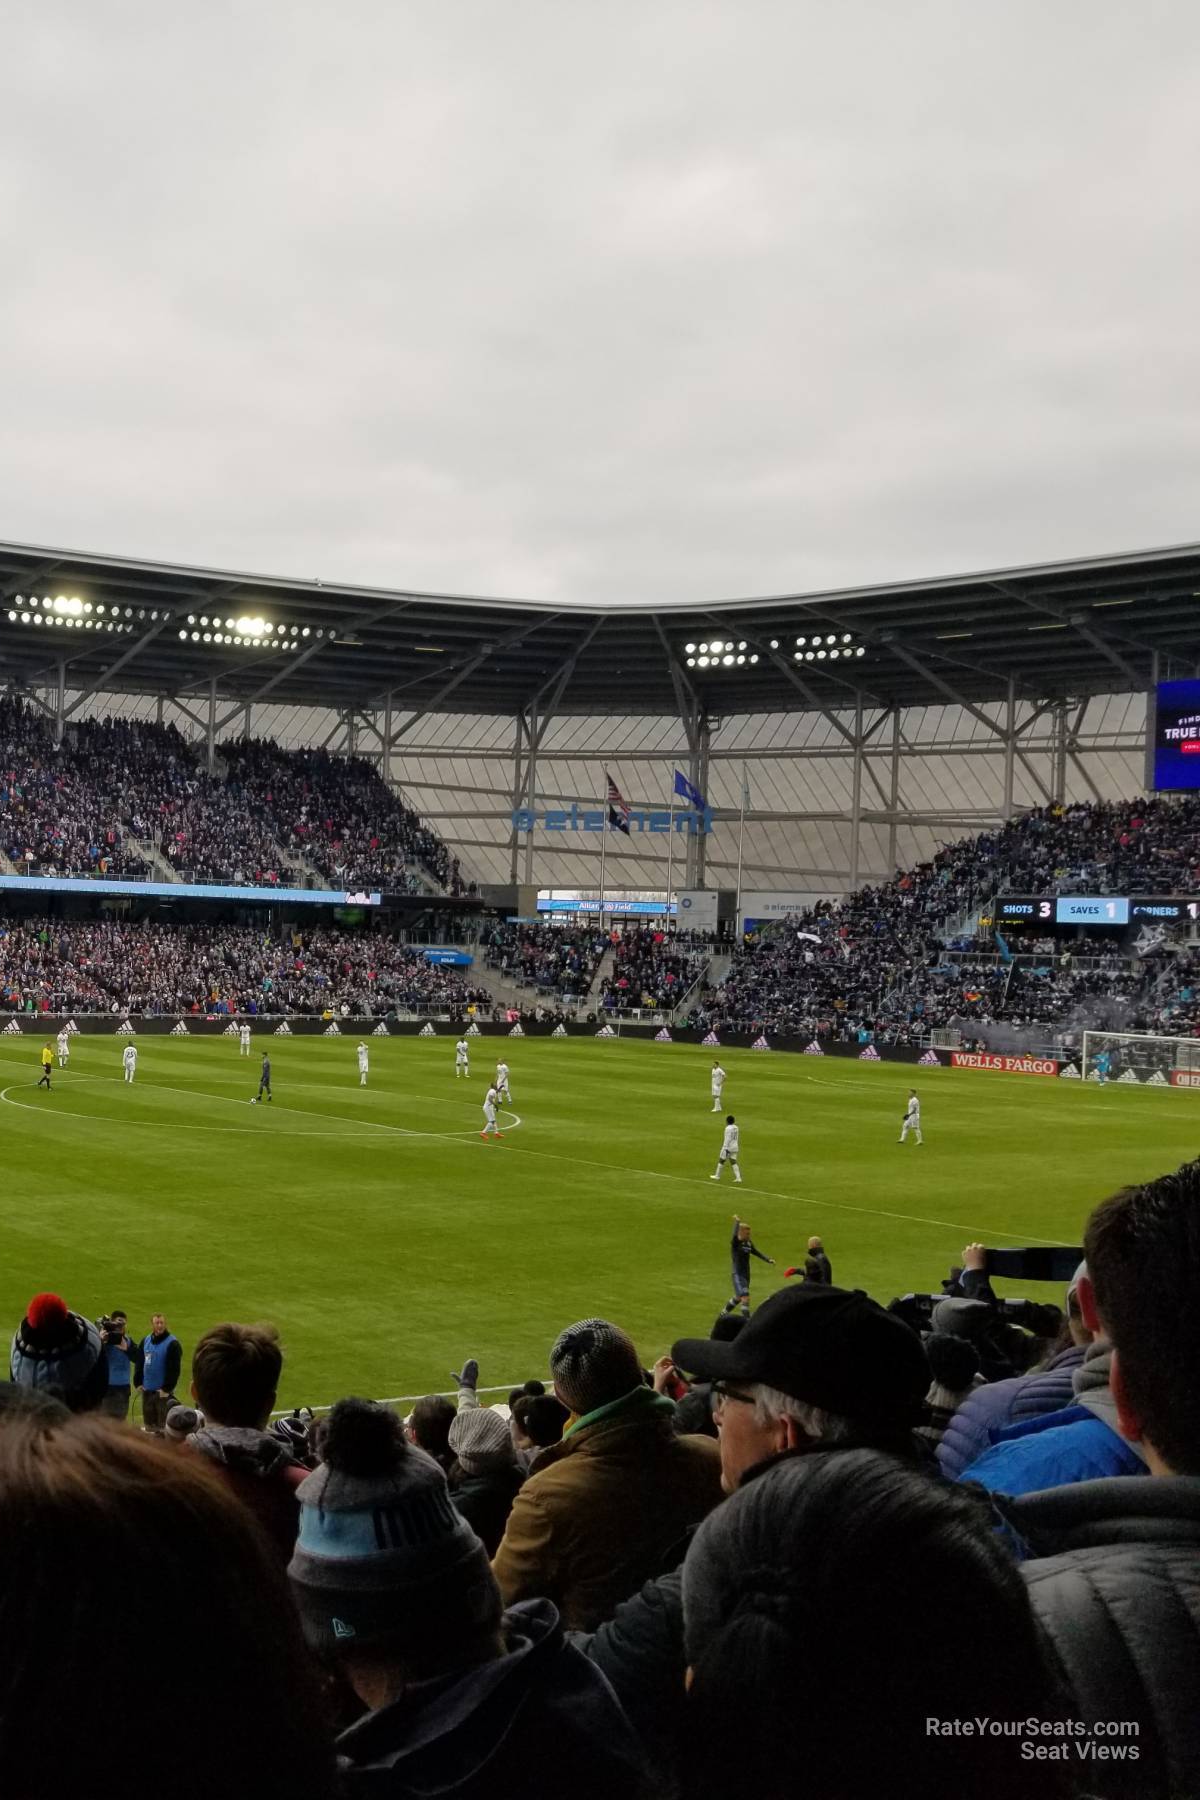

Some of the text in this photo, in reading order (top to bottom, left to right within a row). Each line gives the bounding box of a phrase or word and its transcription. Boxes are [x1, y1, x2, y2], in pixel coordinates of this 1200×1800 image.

[1164, 727, 1198, 740] TRUE
[1003, 902, 1051, 918] SHOTS 3
[1070, 903, 1116, 918] SAVES 1
[1187, 903, 1198, 919] 1
[955, 1053, 1055, 1075] WELLS FARGO
